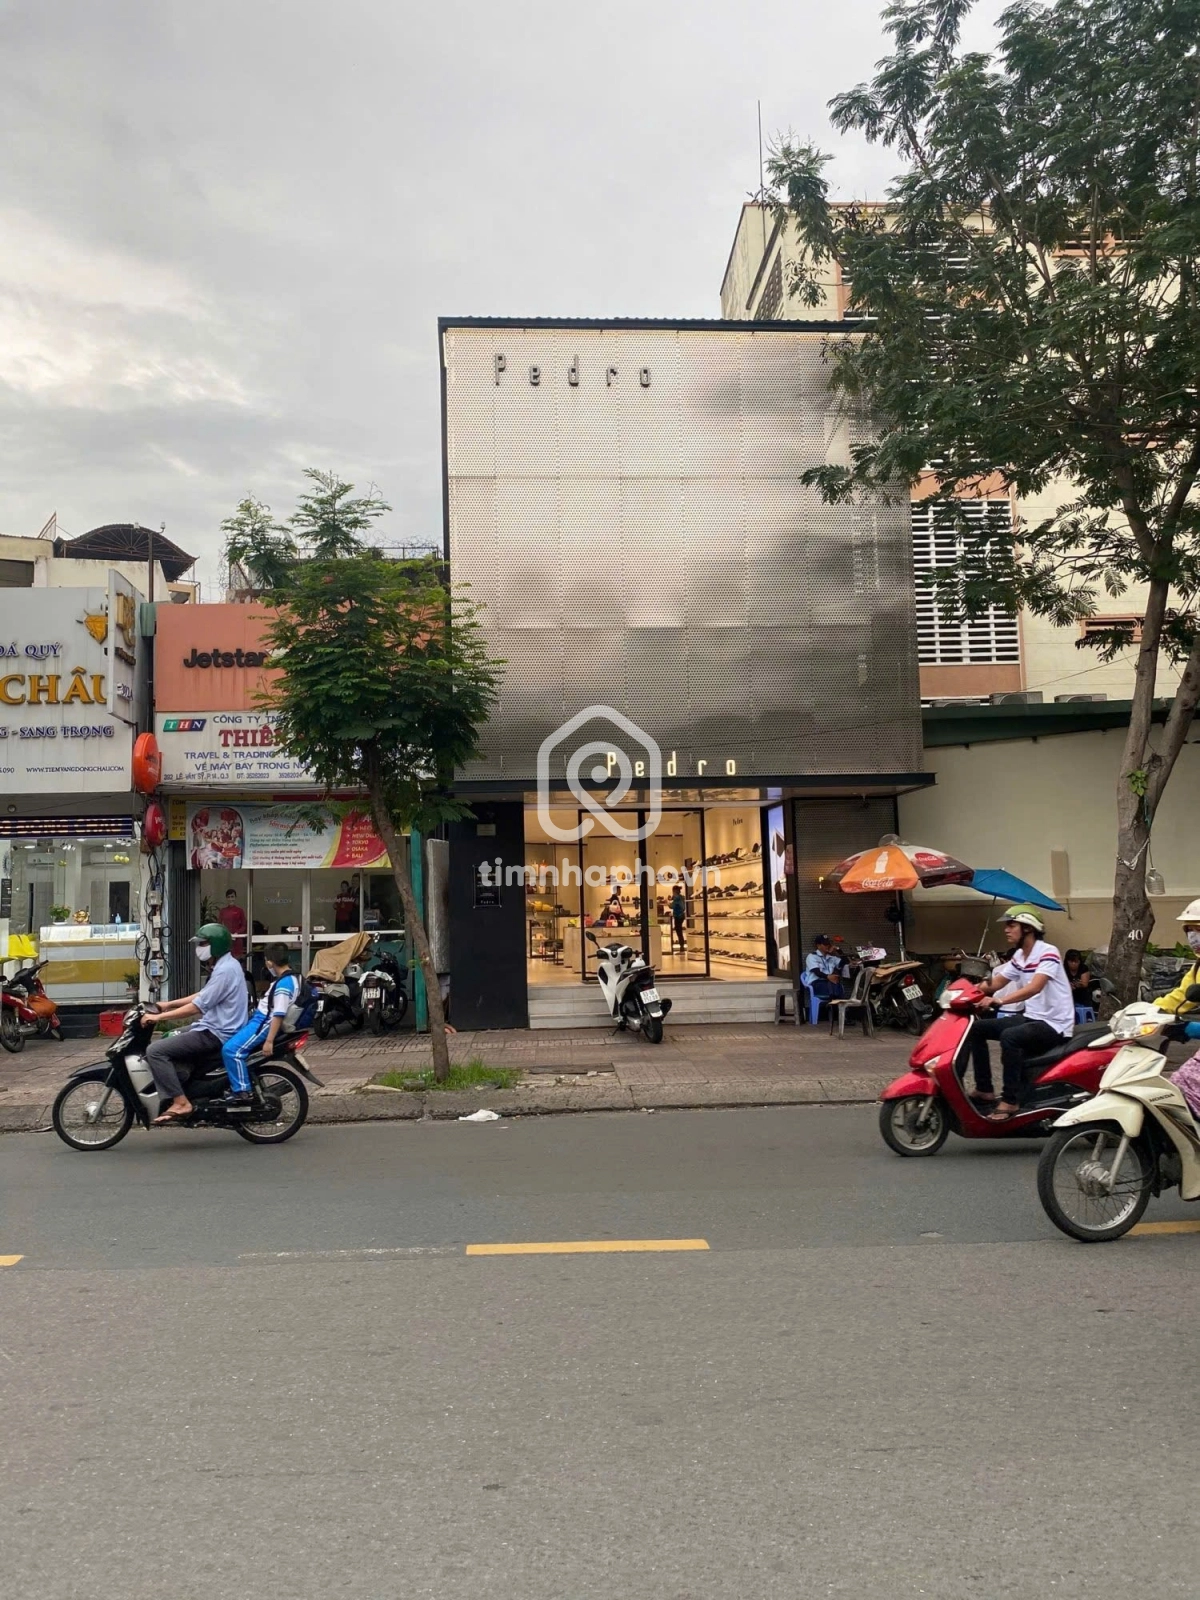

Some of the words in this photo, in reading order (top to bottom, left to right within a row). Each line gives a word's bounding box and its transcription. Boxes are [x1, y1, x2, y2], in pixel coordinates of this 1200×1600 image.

[495, 354, 651, 387] Pedro
[25, 642, 61, 660] QUÝ
[184, 648, 268, 668] Jetstar
[168, 720, 203, 730] THN
[213, 714, 242, 724] CÔNG
[247, 715, 261, 724] TY
[20, 726, 57, 739] SANG
[61, 725, 114, 740] TRỌNG
[184, 751, 219, 759] TRAVEL
[223, 751, 230, 759] &
[210, 761, 233, 770] MÁY
[235, 762, 253, 770] BAY
[257, 762, 290, 770] TRONG
[607, 751, 736, 777] Pedro
[861, 877, 894, 889] Coca-Cola
[1128, 929, 1143, 941] 40
[1149, 1093, 1175, 1102] HONDA
